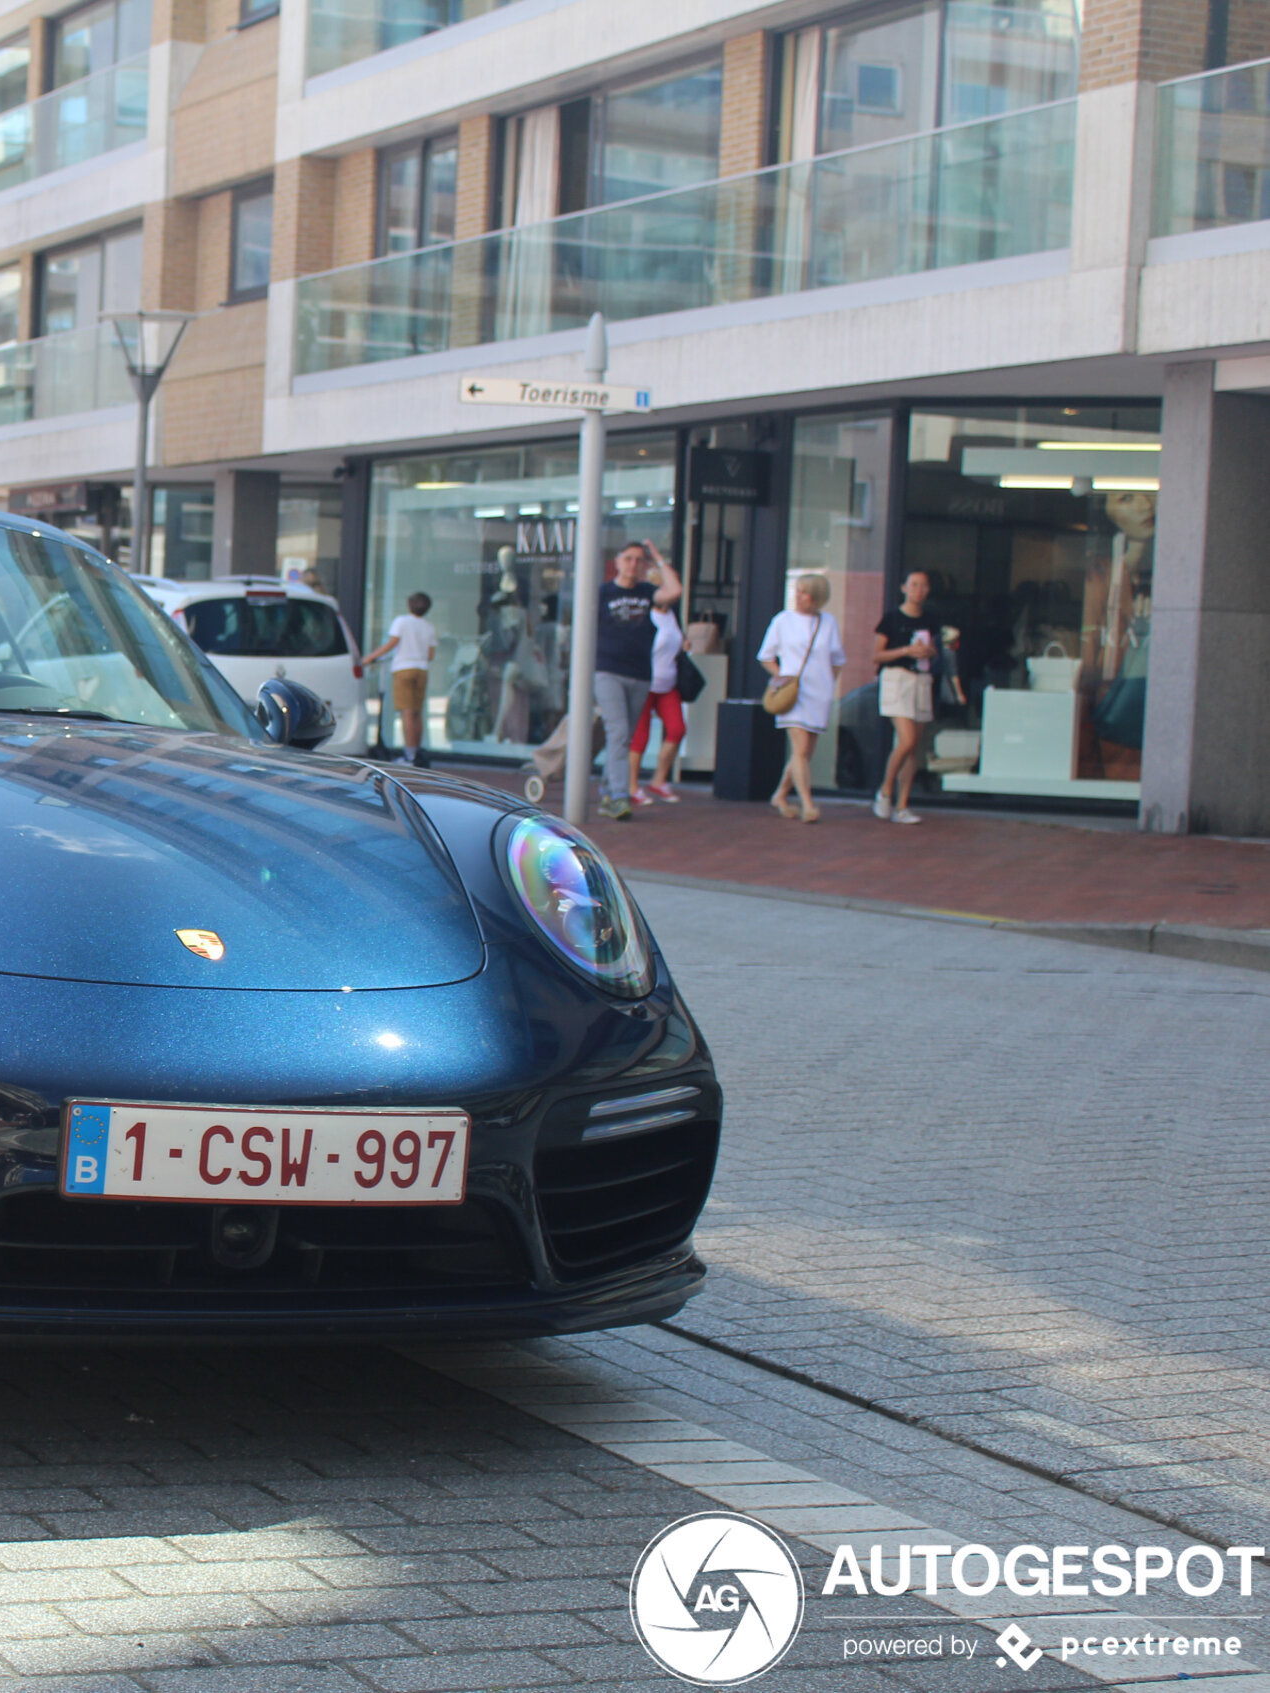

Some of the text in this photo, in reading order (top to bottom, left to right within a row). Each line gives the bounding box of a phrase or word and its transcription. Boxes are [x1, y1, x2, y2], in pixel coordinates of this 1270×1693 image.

[519, 383, 610, 406] Toerisme
[125, 1122, 456, 1189] 1-CSW-997
[74, 1156, 98, 1184] B
